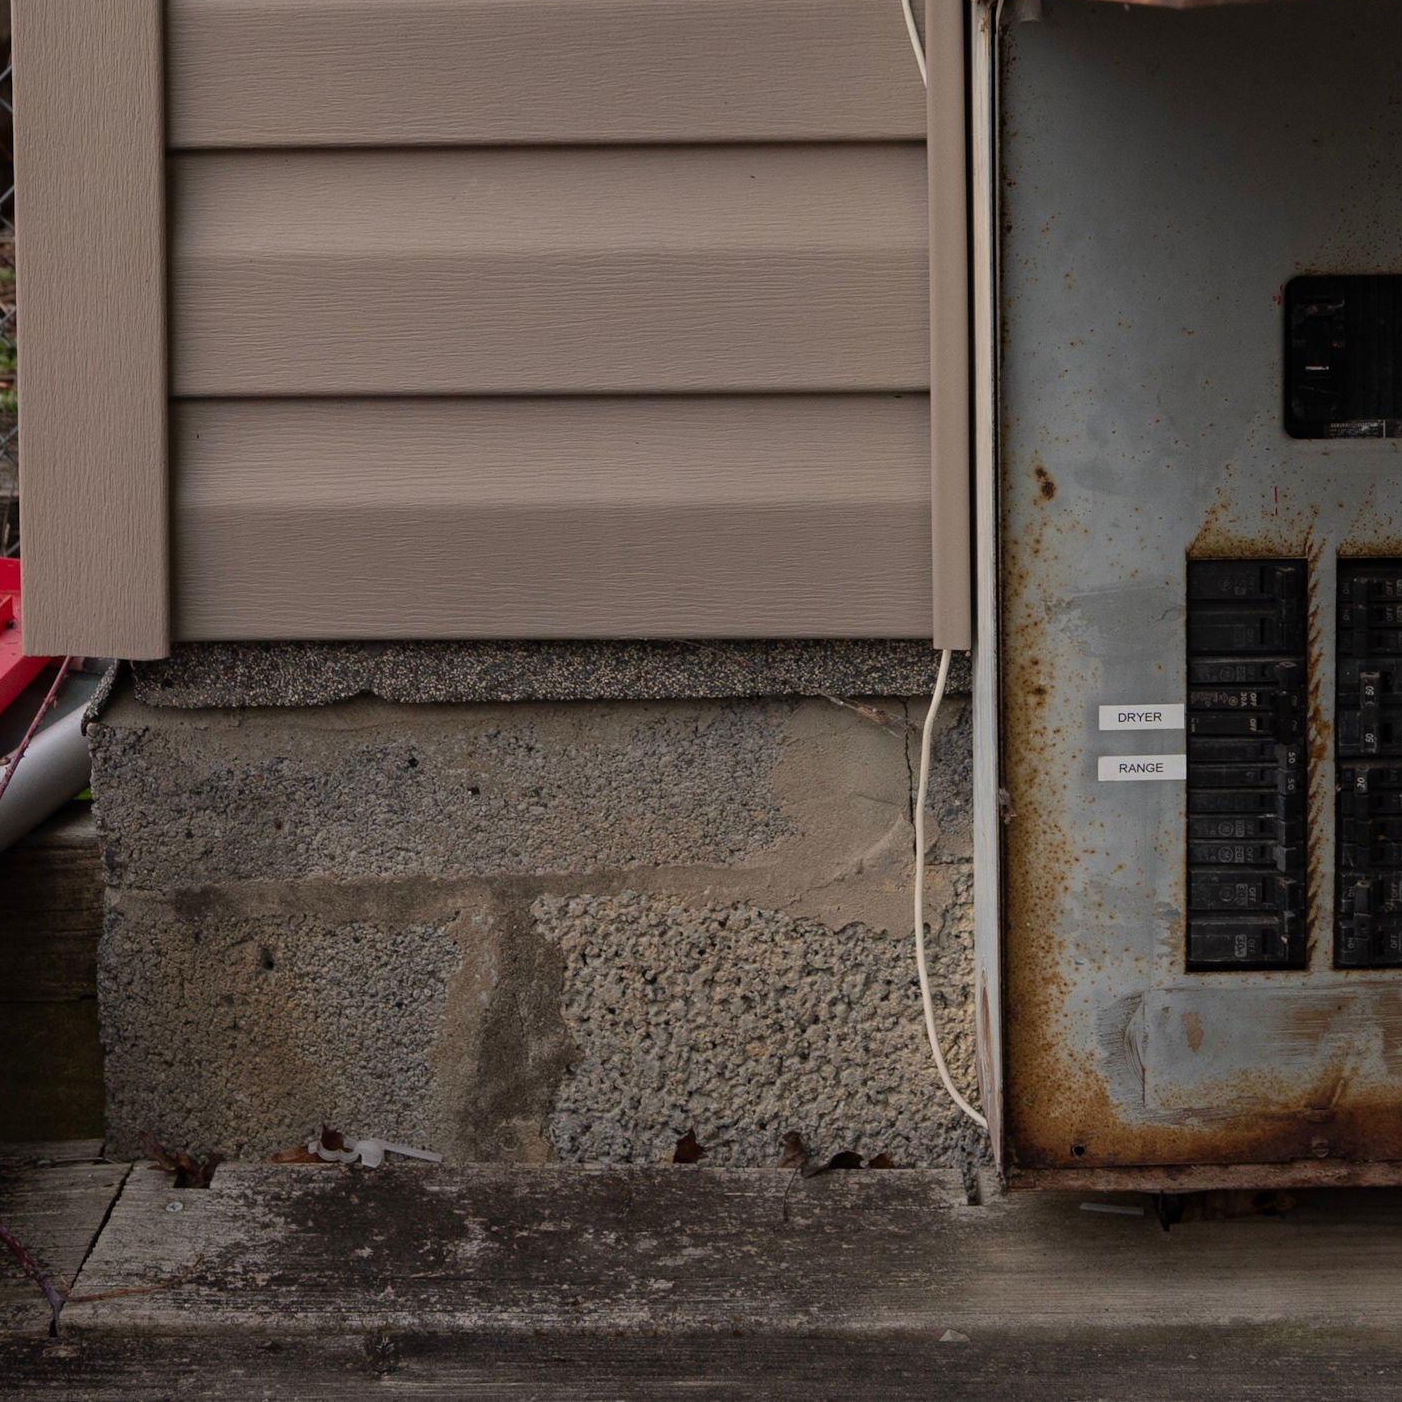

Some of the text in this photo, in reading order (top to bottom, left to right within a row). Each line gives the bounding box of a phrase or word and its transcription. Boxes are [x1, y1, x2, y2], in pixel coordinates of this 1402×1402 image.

[1240, 691, 1248, 707] 30A
[1250, 692, 1258, 707] OFF
[1118, 711, 1162, 723] DRYER
[1288, 751, 1296, 764] 50
[1119, 762, 1164, 774] RANGE
[1287, 777, 1295, 791] 50
[1356, 776, 1365, 789] 20
[1390, 934, 1398, 949] OFF
